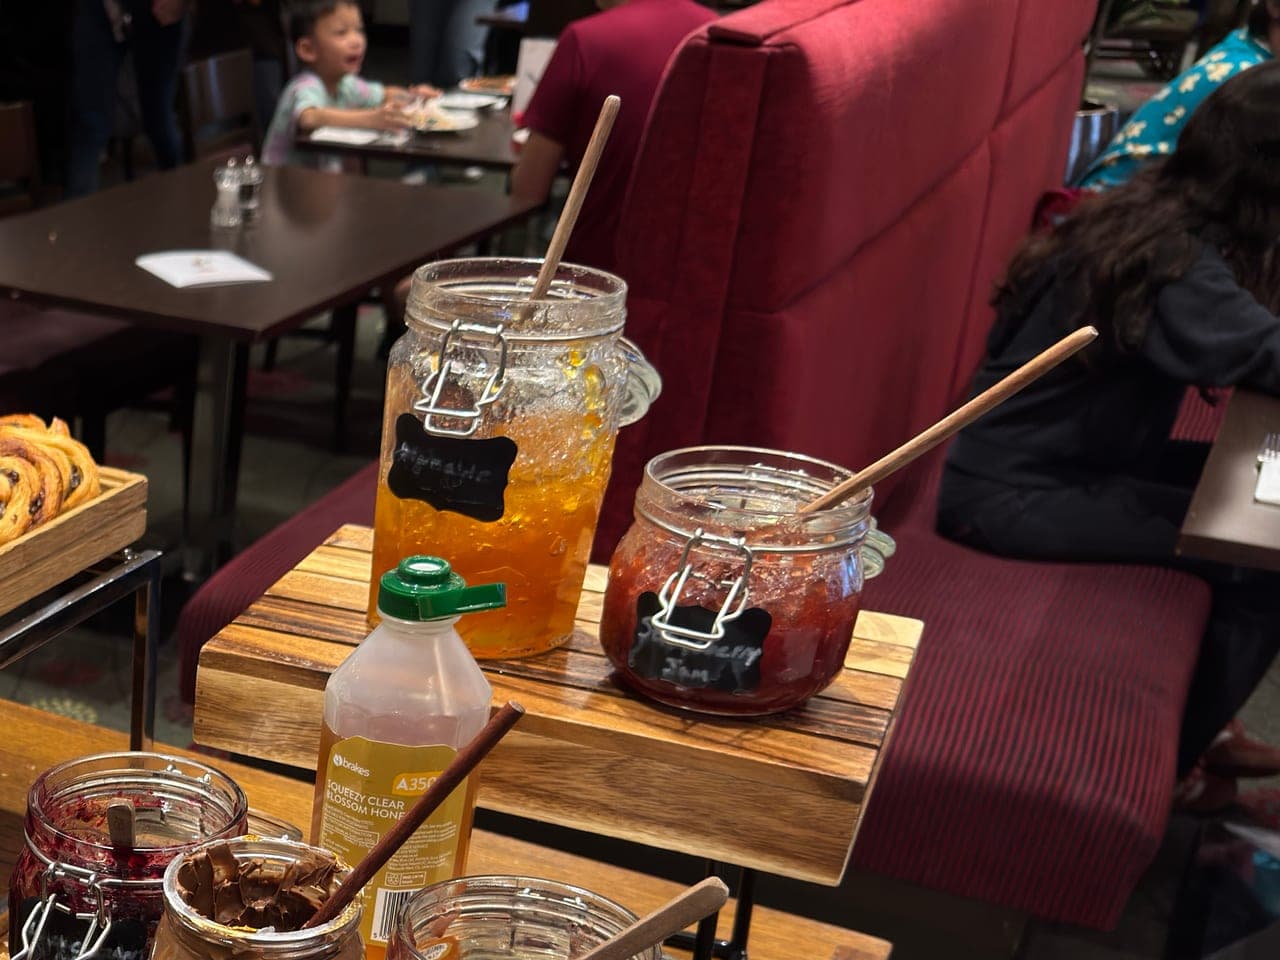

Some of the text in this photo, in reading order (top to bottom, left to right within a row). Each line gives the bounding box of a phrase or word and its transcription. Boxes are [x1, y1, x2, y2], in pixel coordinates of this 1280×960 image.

[342, 756, 370, 777] brakes
[367, 796, 405, 810] CLEAR
[371, 807, 407, 821] HONE
